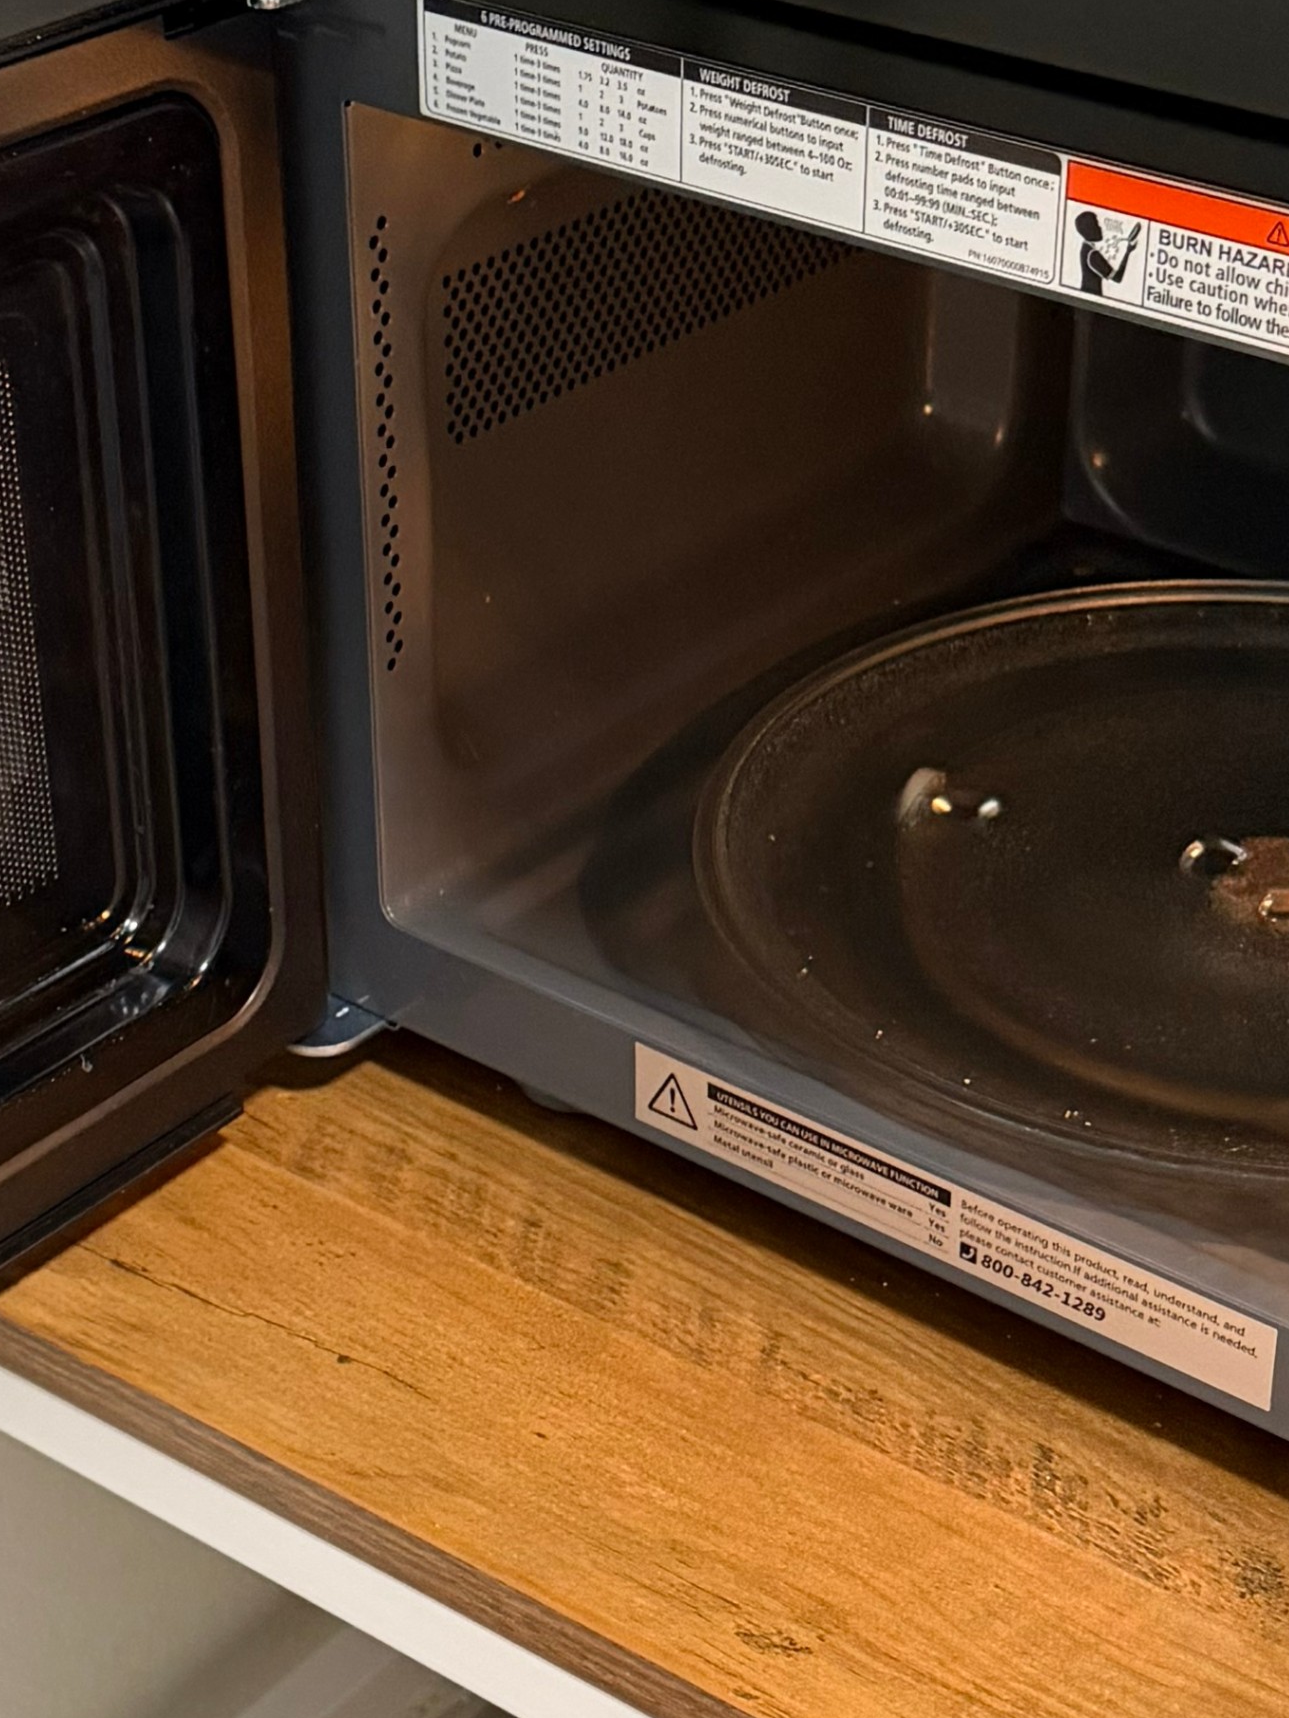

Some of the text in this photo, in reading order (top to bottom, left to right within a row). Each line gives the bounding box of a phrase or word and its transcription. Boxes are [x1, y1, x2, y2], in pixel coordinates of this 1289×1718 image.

[601, 62, 643, 80] QUANTITY
[699, 68, 790, 102] WEIGHT DEFROST
[699, 87, 722, 103] Press
[699, 104, 721, 119] Press
[724, 112, 767, 131] numerical
[769, 121, 804, 141] buttons
[806, 133, 816, 144] to
[818, 135, 843, 151] input
[699, 122, 805, 157] weight ranged between
[887, 115, 968, 147] TIME DEFROST
[699, 135, 721, 151] Press
[799, 163, 810, 175] to
[811, 168, 833, 181] start
[885, 153, 909, 169] Press
[911, 162, 949, 179] number
[950, 172, 973, 186] pads
[976, 178, 986, 189] to
[989, 179, 1015, 197] input
[884, 169, 1039, 219] defrosting time ranged between
[883, 218, 933, 243] defrosting.
[1158, 228, 1212, 257] BURN
[1183, 259, 1210, 277] not
[1215, 265, 1260, 289] allow
[1146, 285, 1192, 312] Failure
[1196, 299, 1212, 316] to
[1215, 302, 1262, 330] follow
[1188, 279, 1248, 305] caution
[713, 1134, 773, 1168] Metal utensil
[928, 1217, 944, 1232] Yes
[929, 1202, 946, 1217] Yes
[928, 1233, 943, 1246] No
[959, 1228, 992, 1249] please
[994, 1245, 1034, 1269] contact
[1036, 1265, 1087, 1292] customer
[1089, 1289, 1144, 1319] assistance
[960, 1199, 1245, 1336] Before operating this product, read, understand, and
[959, 1212, 992, 1235] follow
[994, 1229, 1011, 1244] the
[1083, 1271, 1138, 1302] additional
[1141, 1298, 1197, 1329] assistance
[1200, 1322, 1208, 1335] is
[1212, 1331, 1257, 1358] needed,
[980, 1254, 1105, 1321] 800-842-1289
